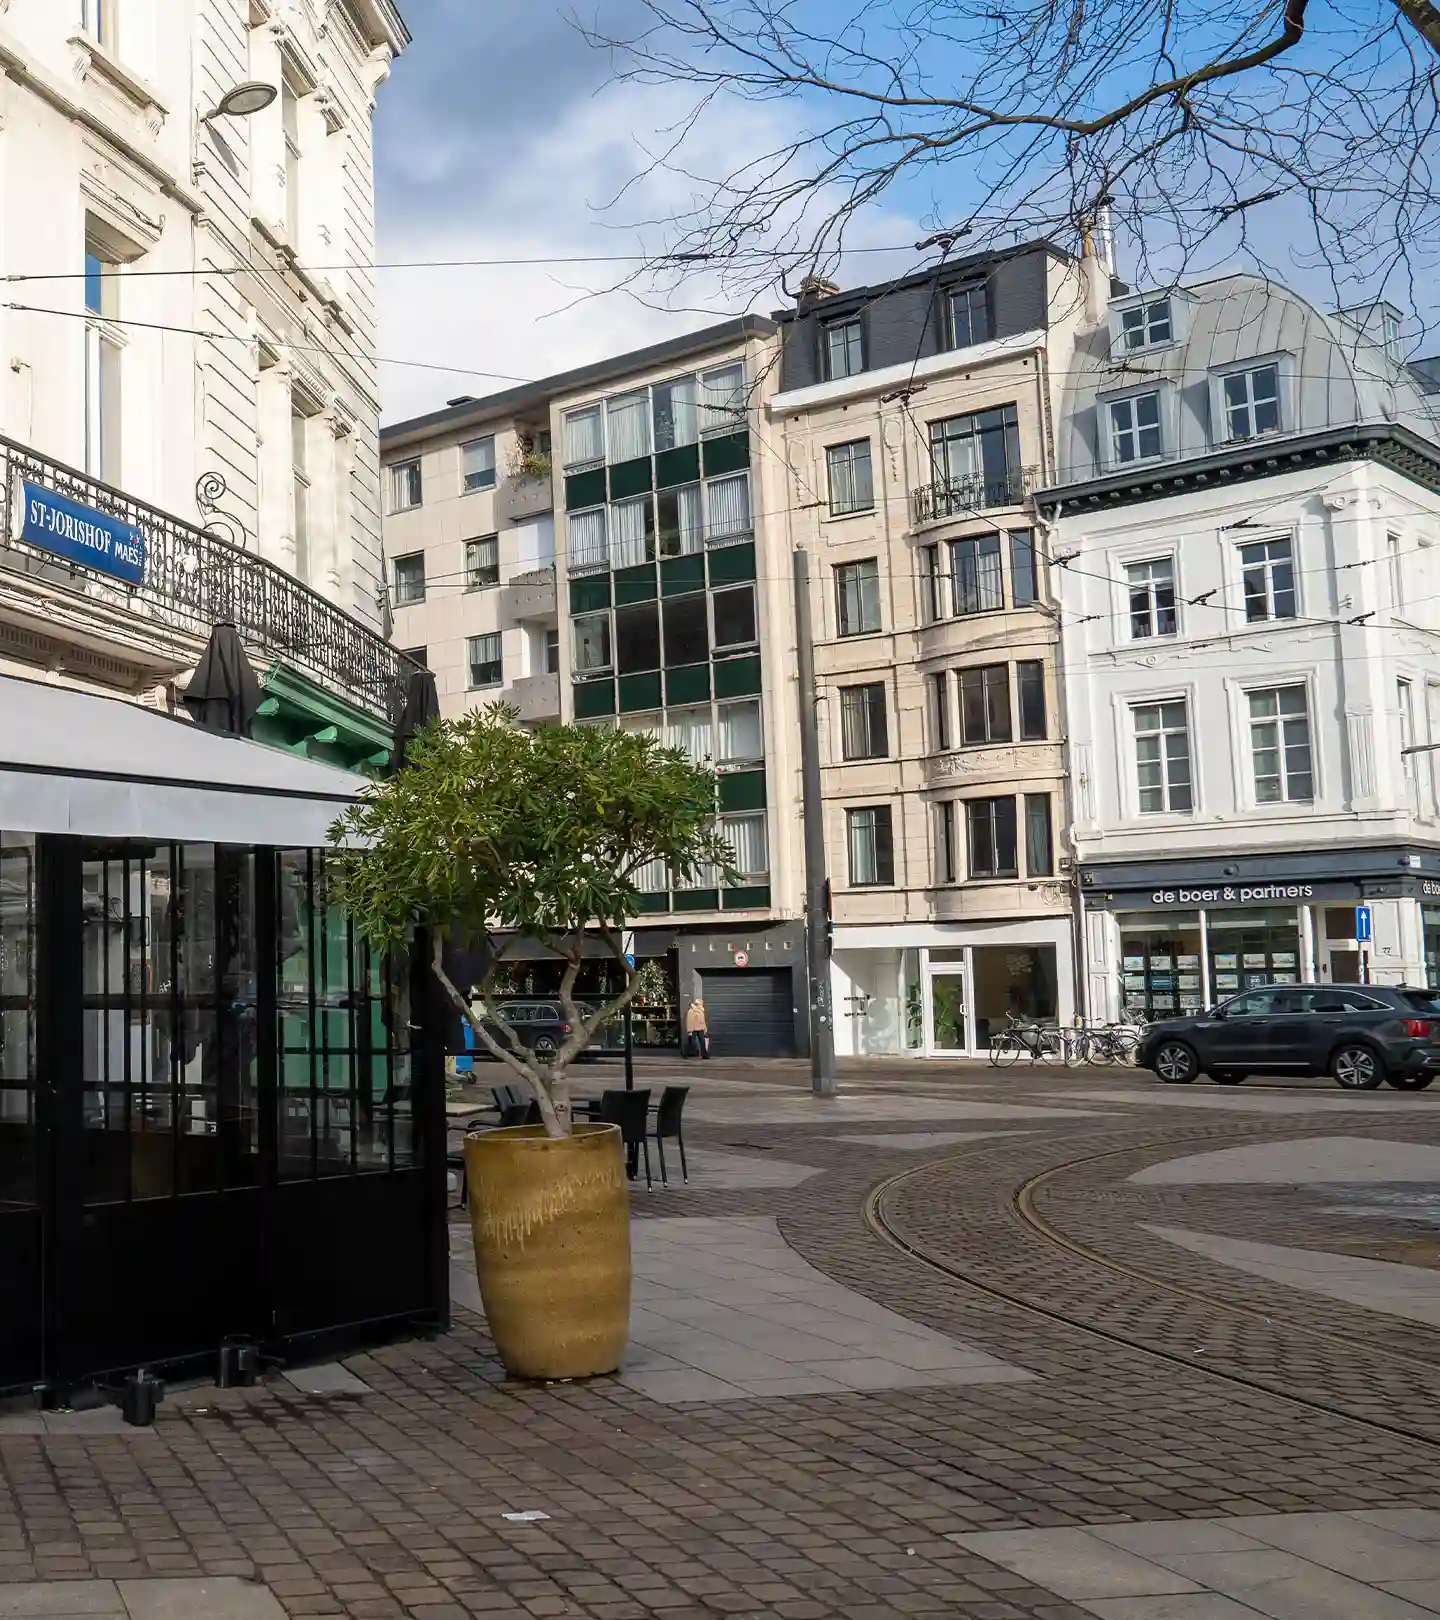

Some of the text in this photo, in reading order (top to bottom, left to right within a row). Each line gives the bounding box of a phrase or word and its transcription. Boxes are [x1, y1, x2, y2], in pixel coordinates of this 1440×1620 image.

[30, 500, 112, 554] ST-JORISHOF
[115, 541, 139, 565] MAES
[1152, 884, 1313, 903] de boer & partners
